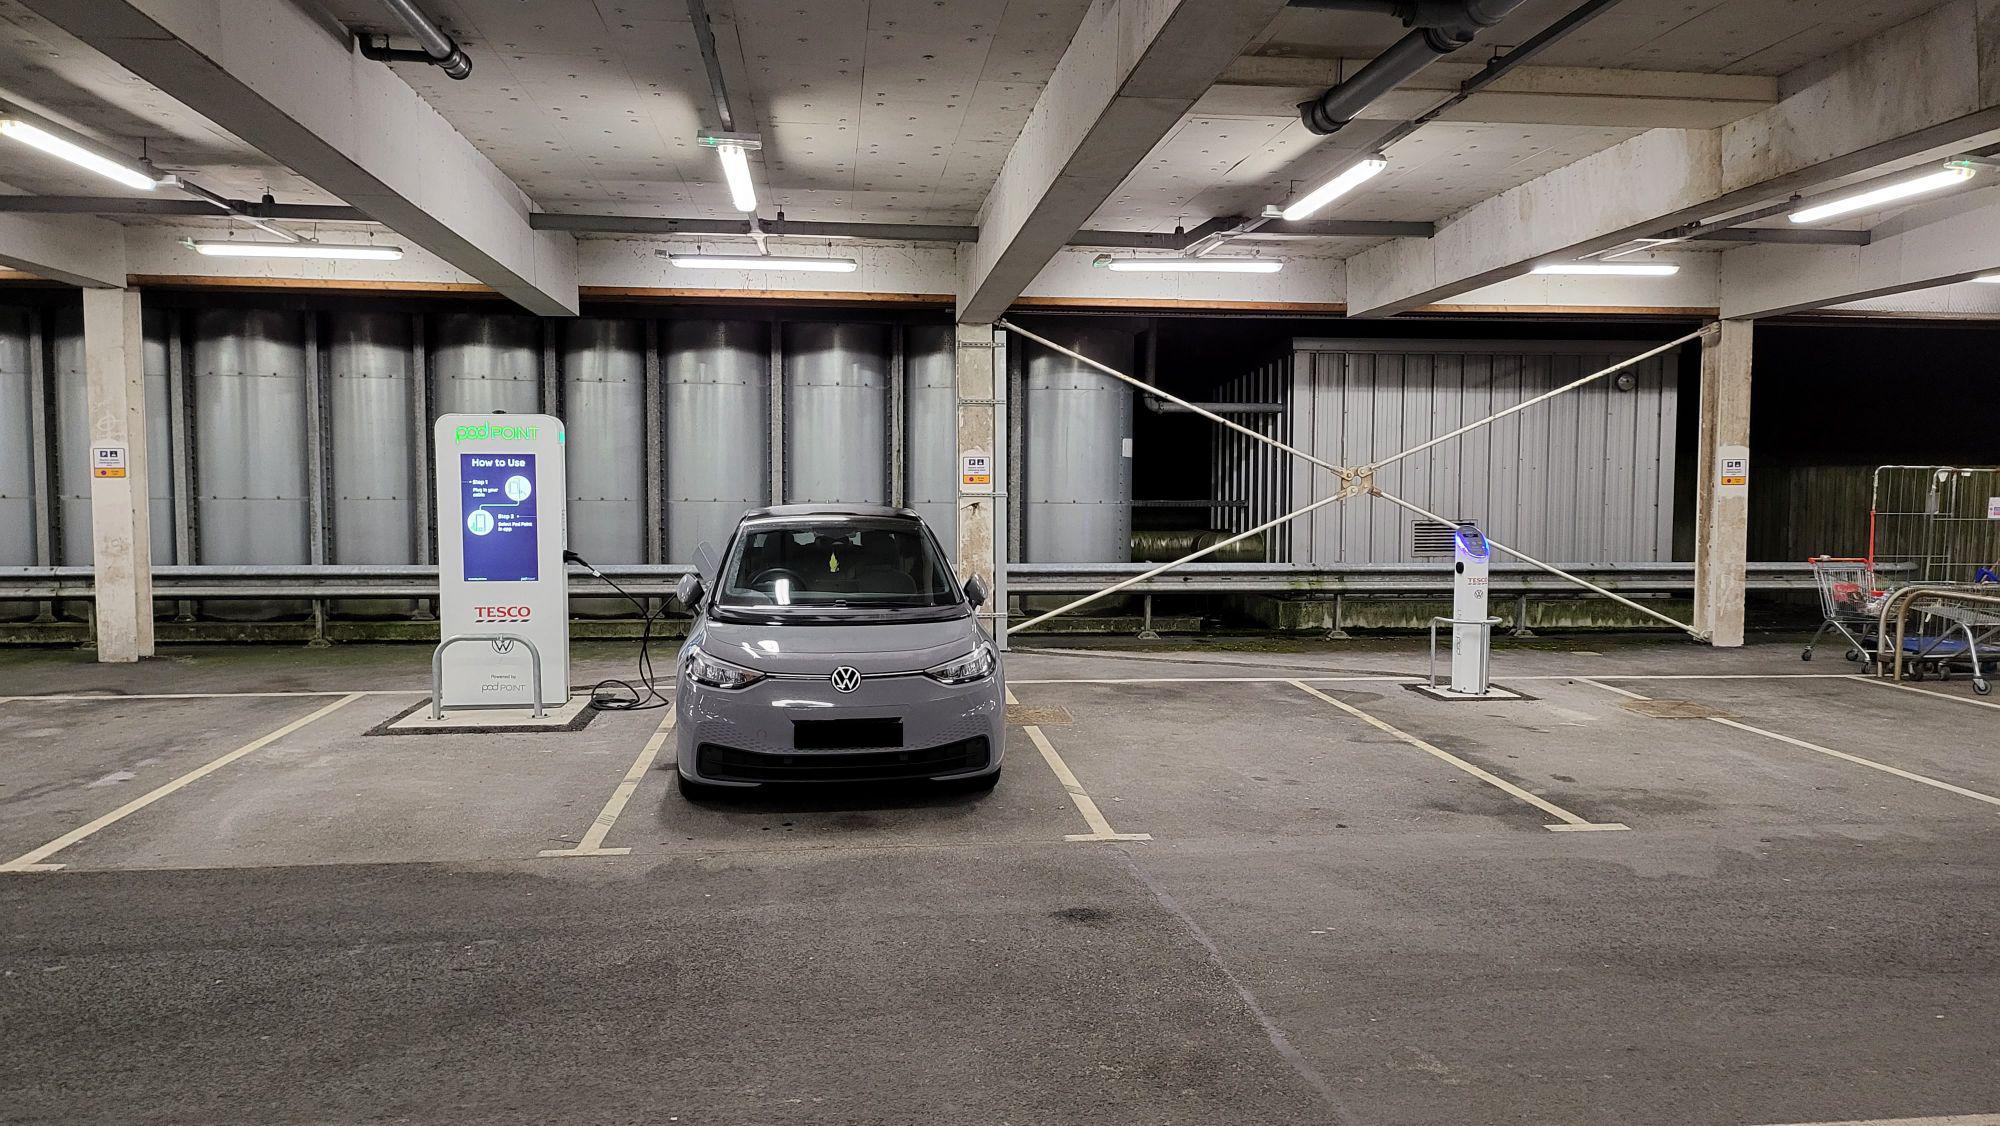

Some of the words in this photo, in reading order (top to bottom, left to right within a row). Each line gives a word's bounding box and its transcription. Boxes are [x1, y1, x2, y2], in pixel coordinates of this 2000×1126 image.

[455, 421, 489, 444] pod
[491, 426, 540, 440] POINT
[471, 458, 493, 468] How
[495, 458, 506, 468] to
[507, 458, 526, 468] Use
[474, 606, 531, 618] TESCO
[481, 682, 499, 693] pod
